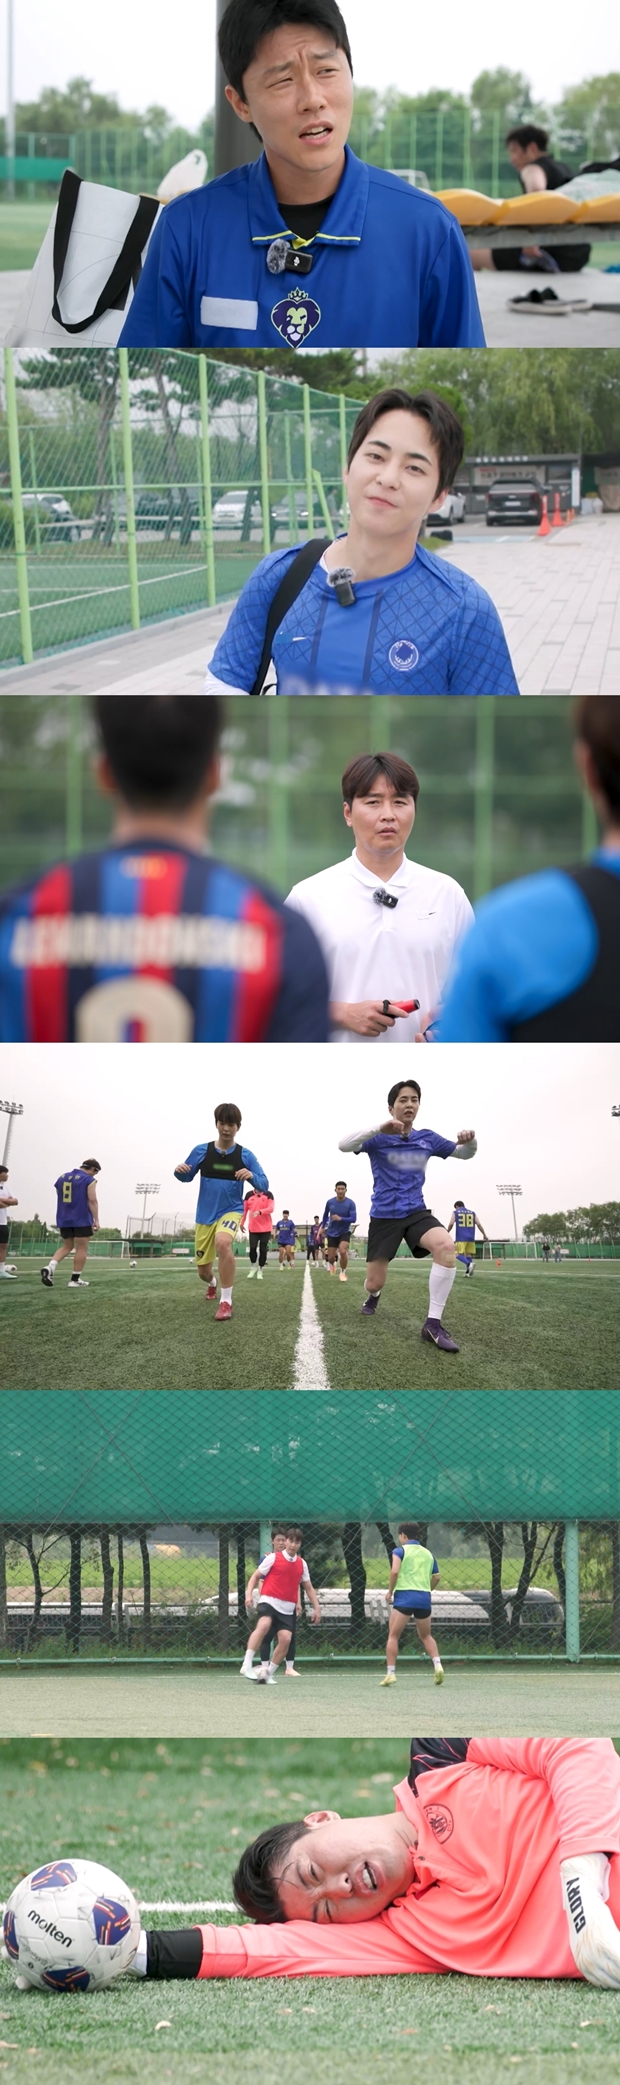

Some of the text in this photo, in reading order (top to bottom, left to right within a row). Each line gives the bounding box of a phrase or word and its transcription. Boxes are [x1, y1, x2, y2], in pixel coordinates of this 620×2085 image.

[62, 1181, 72, 1203] 8
[458, 1213, 474, 1227] 38
[566, 1876, 587, 1935] GLORY
[27, 1909, 74, 1949] molten
